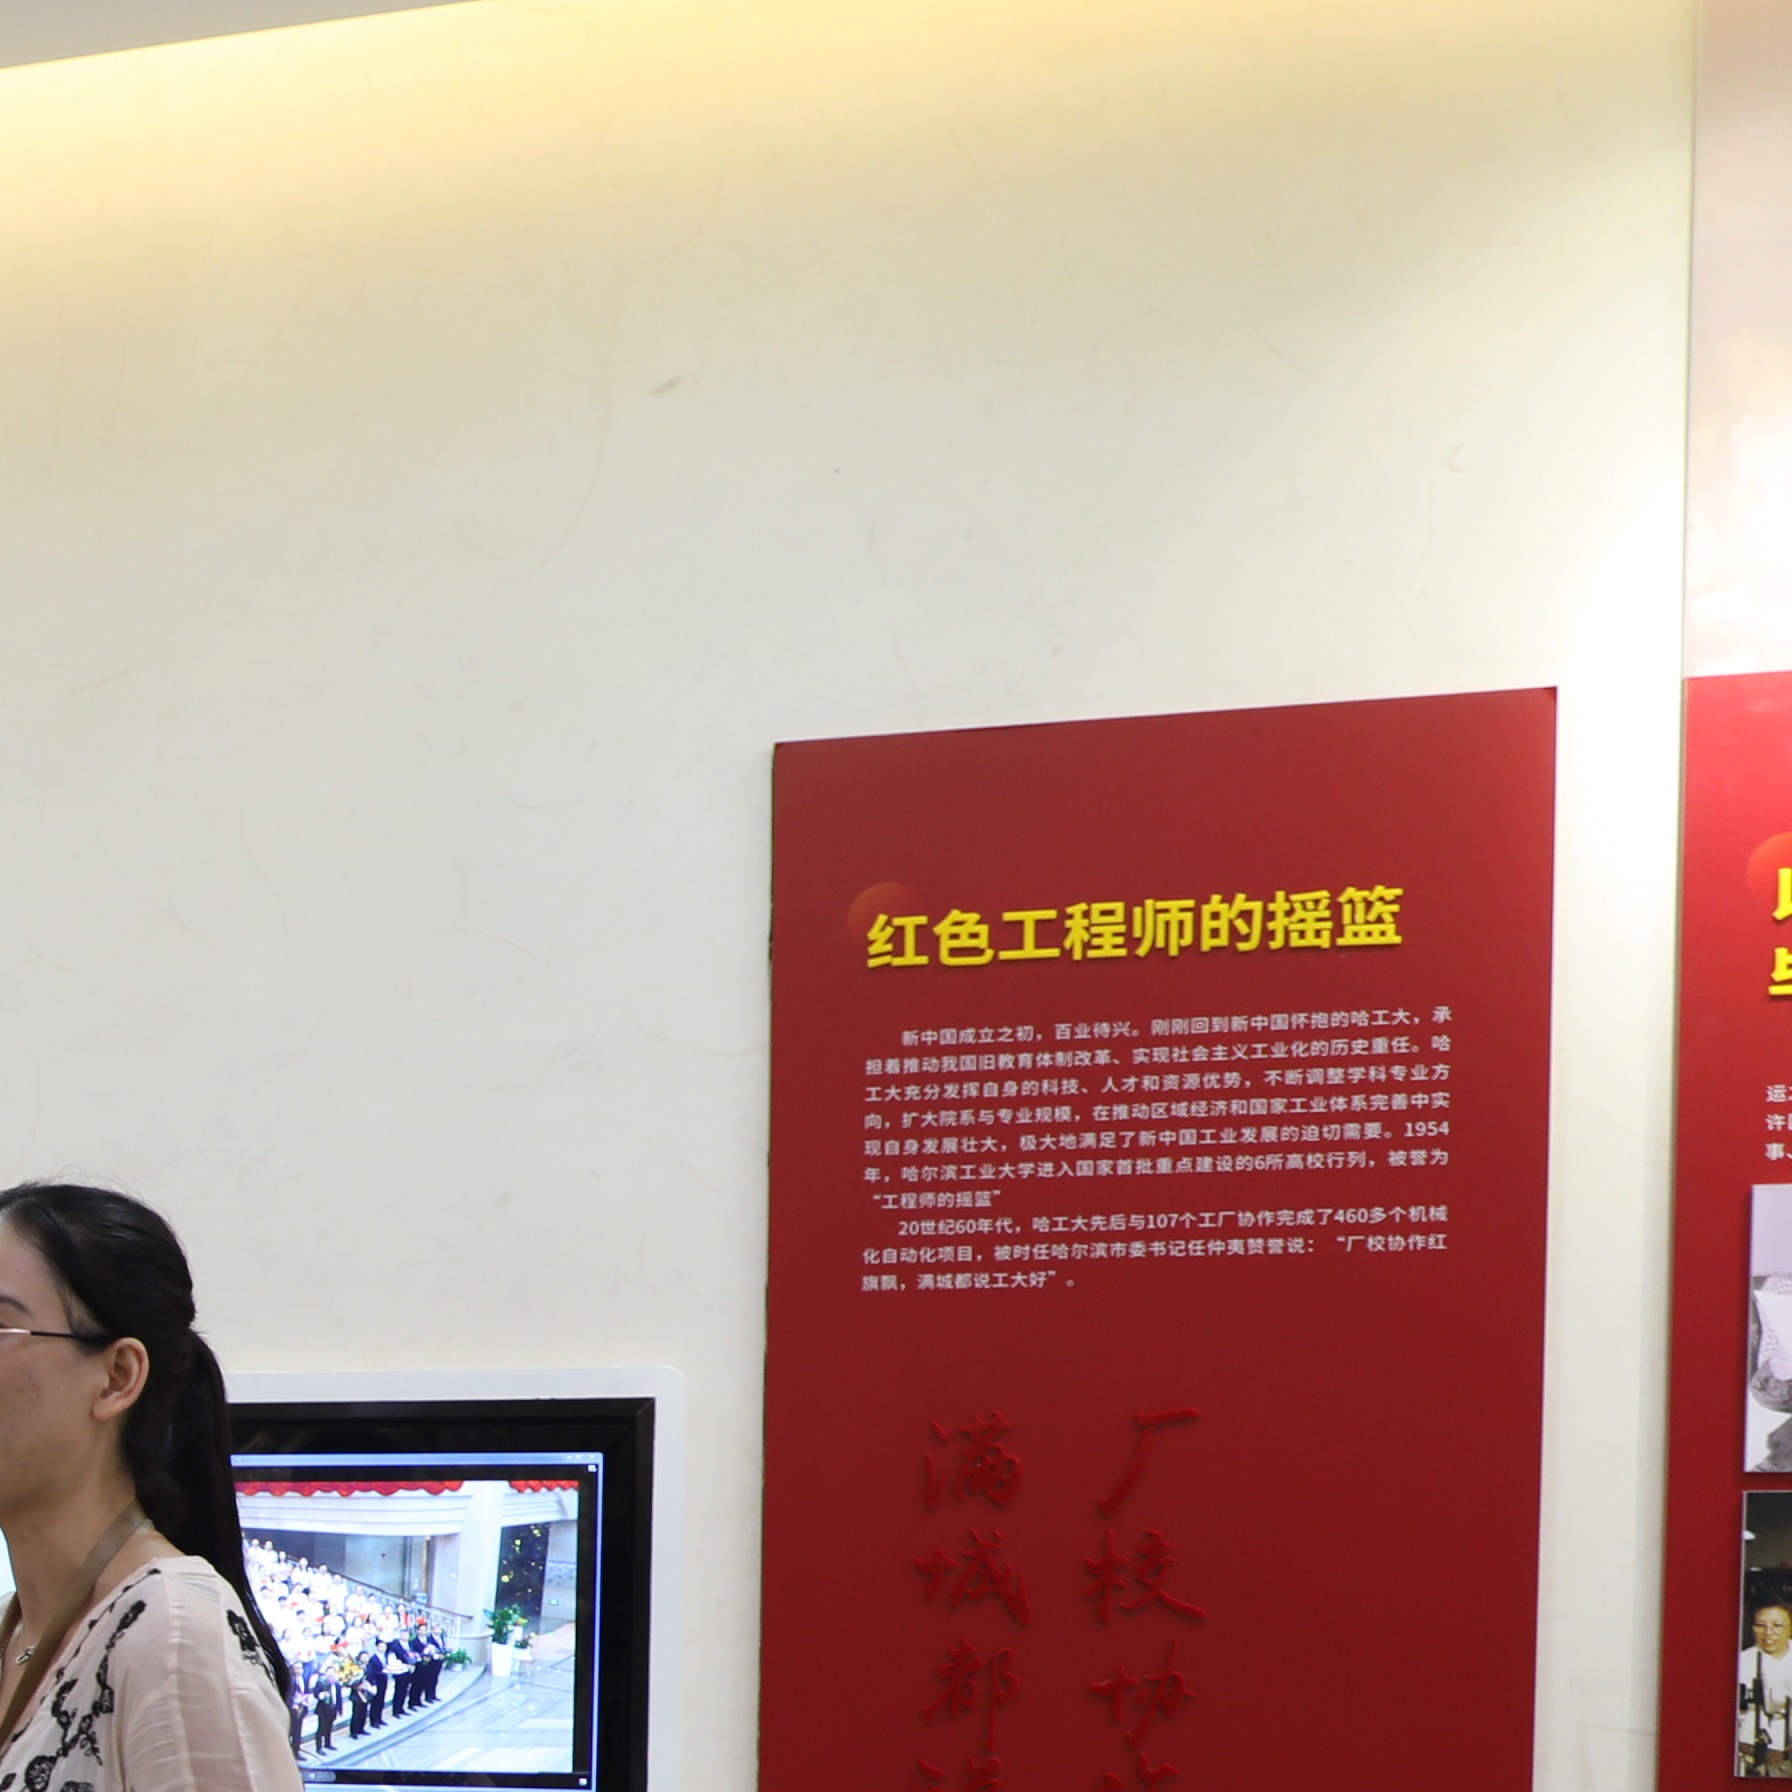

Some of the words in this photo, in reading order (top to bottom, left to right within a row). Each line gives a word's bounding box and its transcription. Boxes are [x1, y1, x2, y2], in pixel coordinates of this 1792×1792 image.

[867, 885, 1403, 970] 红色工程师的摇篮
[901, 1006, 1452, 1046] 新中国成立之初，百业待兴。刚刚回到新中国怀抱的哈工大，承
[866, 1035, 1451, 1076] 担着推动我国旧教育体制改革、实现社会主义工业化的历史重任。哈
[866, 1064, 1450, 1101] 工大充分发挥自身的科技、人才和资源优势，不断调整学科专业方
[865, 1092, 1450, 1129] 向，扩大院系与专业规模，在推动区域经济和国家工业体系完善中实
[864, 1149, 1449, 1183] 年，哈尔滨工业大学进入国家首批重点建设的6所高校行列，被誉为
[873, 1190, 1001, 1209] “工程师的摇篮”
[898, 1205, 1448, 1236] 20世纪60年代，哈工大先后与107个工厂协作完成了460多个机械
